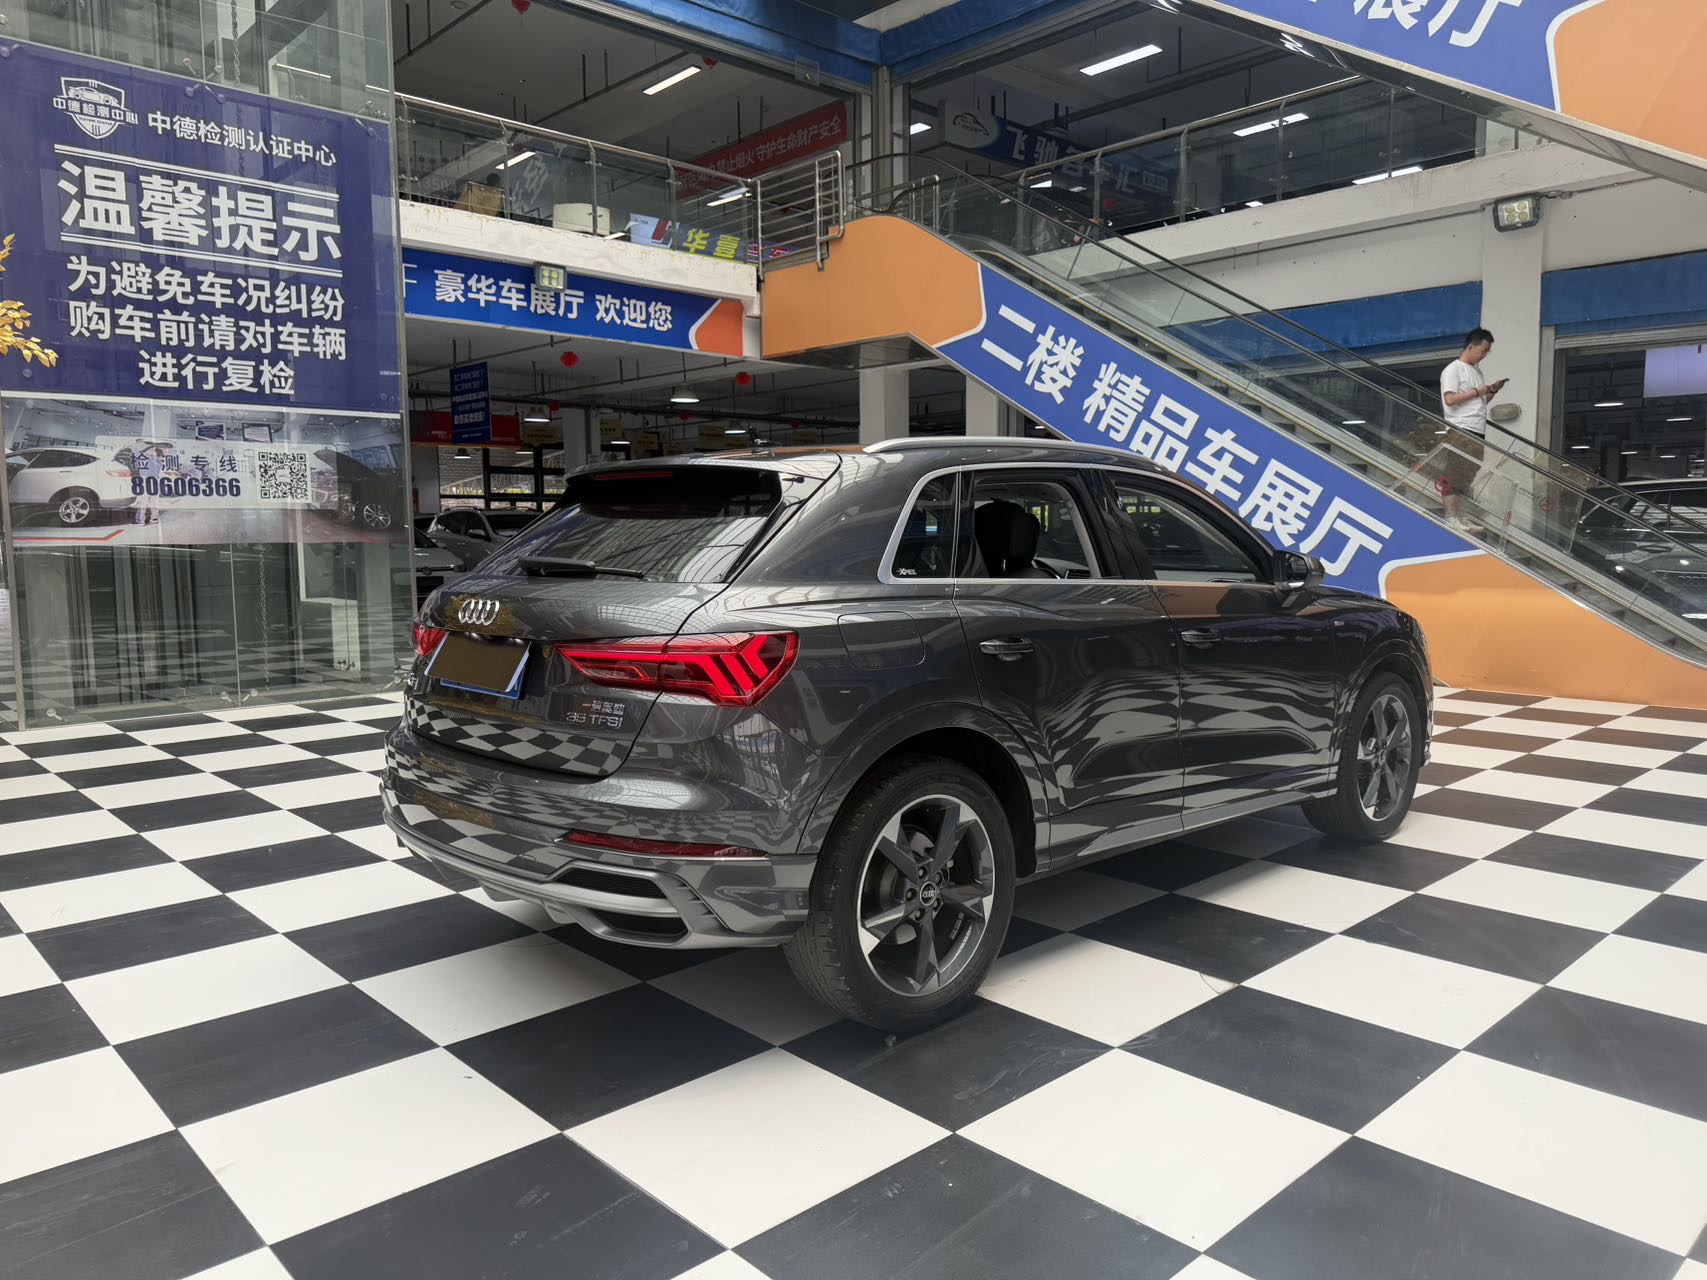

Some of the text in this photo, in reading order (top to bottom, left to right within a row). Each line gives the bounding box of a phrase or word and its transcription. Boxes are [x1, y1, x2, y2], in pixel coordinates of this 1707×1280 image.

[147, 110, 337, 167] 中德检测认证中心
[57, 160, 342, 262] 温馨提示
[66, 255, 345, 322] 为避免车况纠纷
[433, 268, 585, 320] 豪华车展厅
[594, 293, 673, 332] 欢迎您
[69, 300, 347, 361] 购车前请对车辆
[138, 350, 295, 396] 进行复检
[130, 452, 238, 473] 检测专线
[980, 304, 1395, 577] 二楼 精品车展厅
[131, 475, 241, 497] 80606366
[565, 711, 623, 729] 35 TFSI
